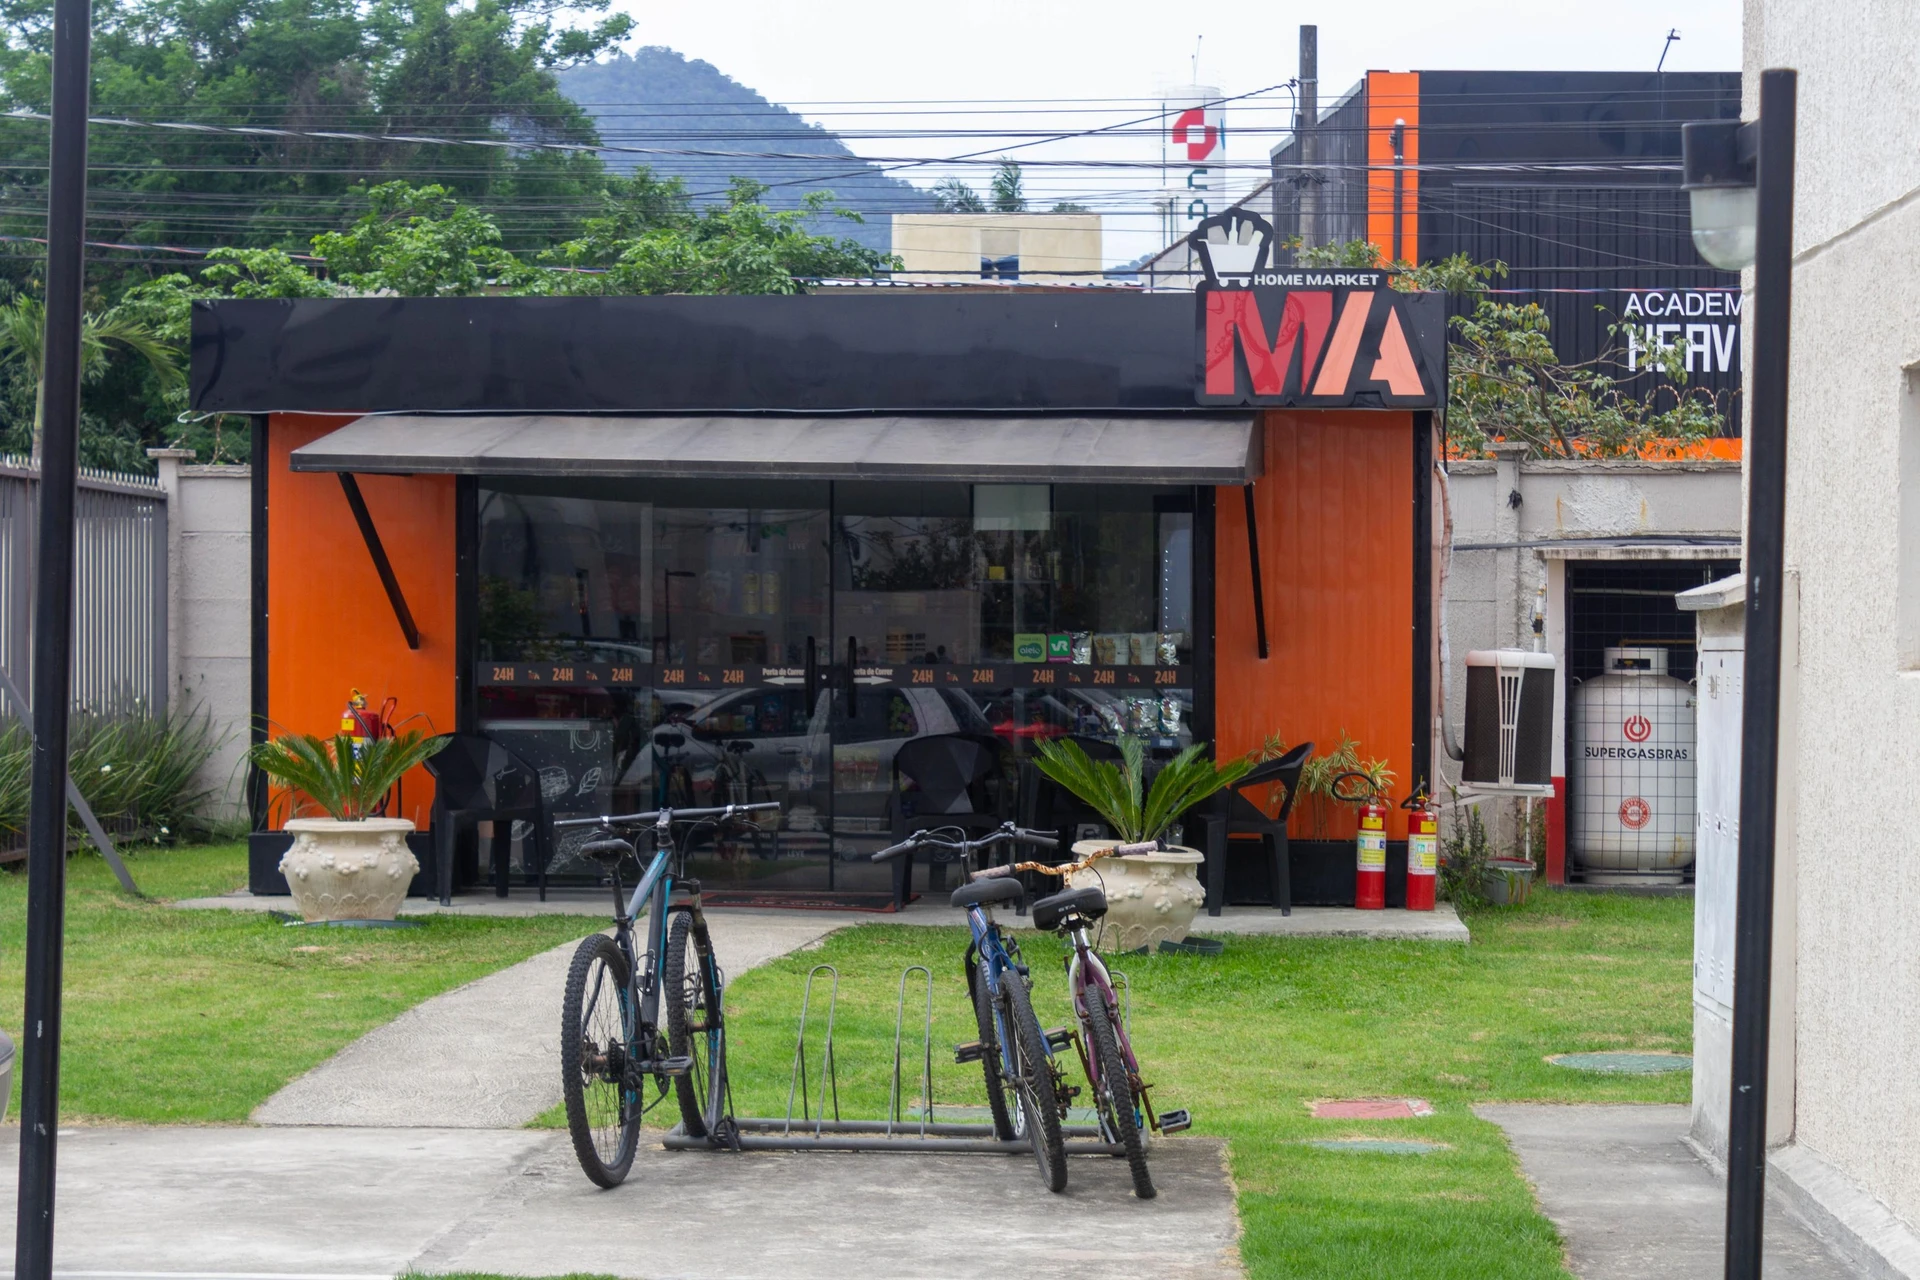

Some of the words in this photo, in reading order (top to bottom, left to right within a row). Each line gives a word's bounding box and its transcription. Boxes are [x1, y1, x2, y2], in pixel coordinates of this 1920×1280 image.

[1254, 274, 1303, 286] HOME
[1306, 274, 1379, 286] MARKET
[1624, 292, 1742, 317] ACADEM
[1628, 323, 1742, 373] HEAV
[1050, 640, 1068, 652] VR
[494, 668, 514, 680] 24H
[553, 668, 573, 681] 24H
[612, 668, 633, 681] 24H
[664, 669, 684, 683] 24H
[724, 670, 744, 682] 24H
[913, 670, 933, 682] 24H
[973, 670, 993, 682] 24H
[1034, 670, 1054, 682] 24H
[1094, 670, 1115, 683] 24H
[1155, 671, 1176, 684] 24H
[1585, 747, 1688, 760] SUPERGASBRAS
